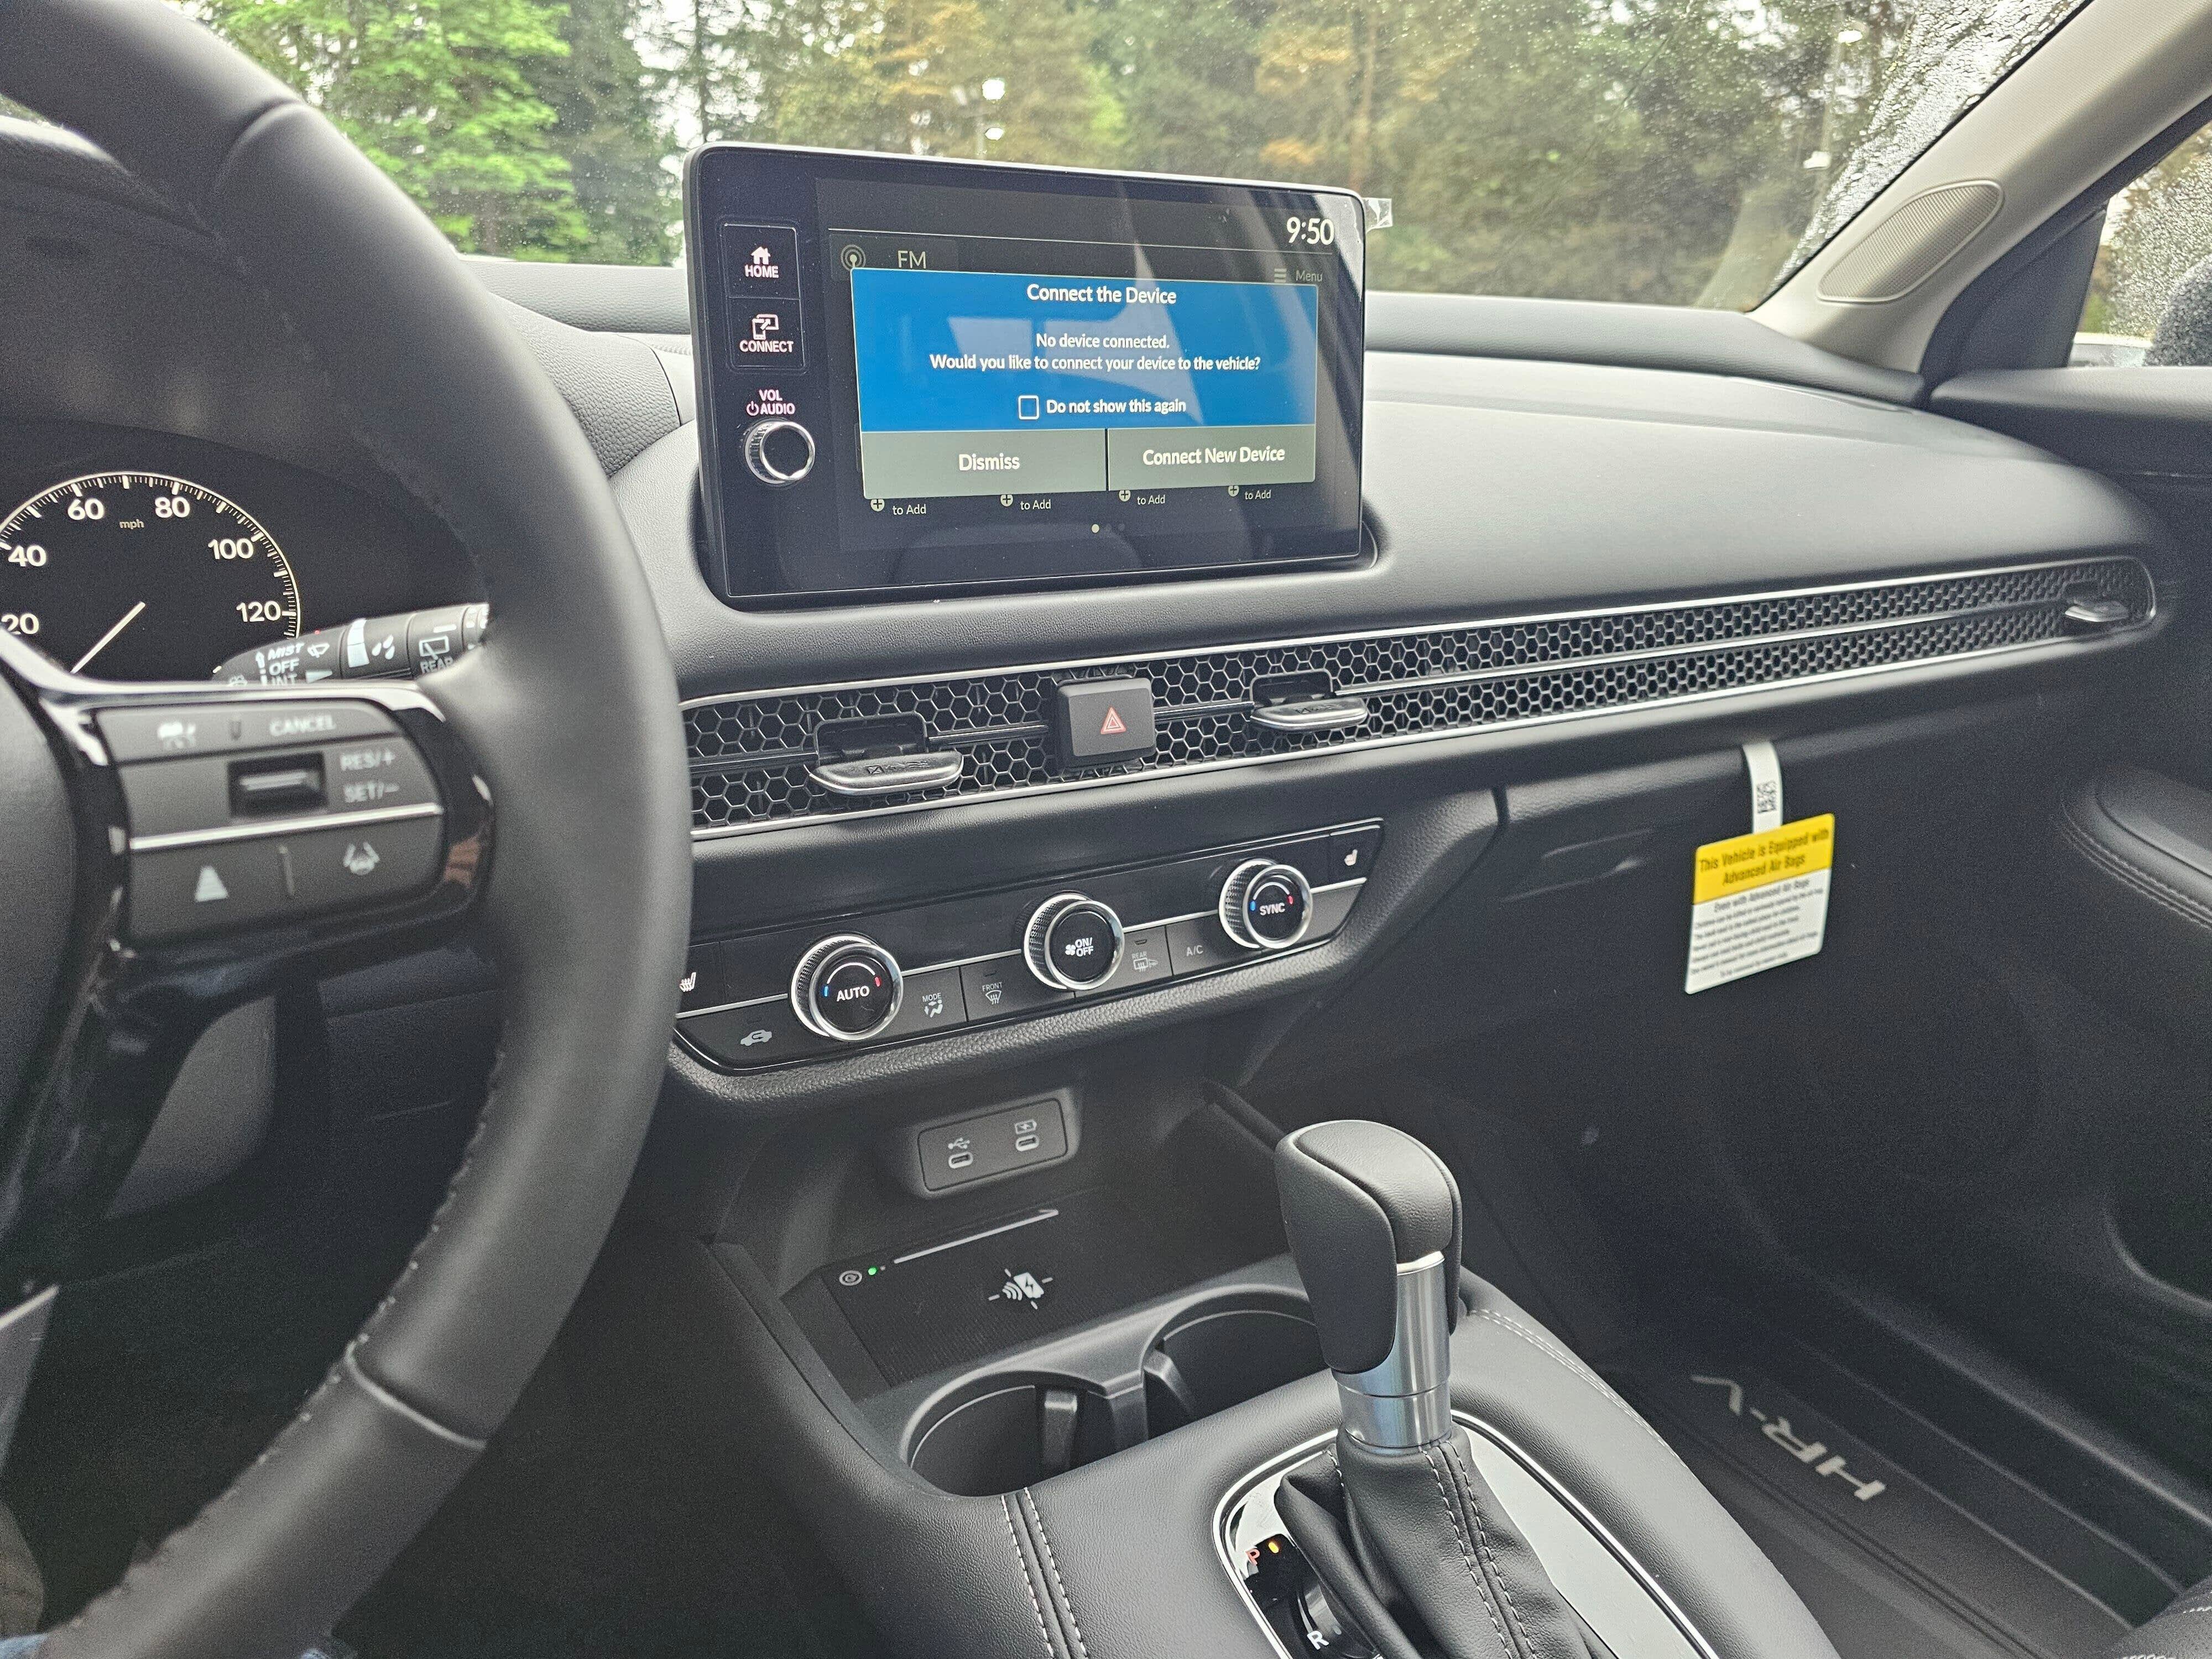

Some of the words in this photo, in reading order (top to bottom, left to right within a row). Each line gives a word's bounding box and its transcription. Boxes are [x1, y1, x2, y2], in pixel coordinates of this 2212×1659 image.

[1287, 217, 1334, 245] 9:50
[898, 251, 927, 269] FM
[745, 265, 779, 279] HOME
[1296, 270, 1322, 282] Menu
[1027, 284, 1093, 302] Connect
[1097, 286, 1121, 302] the
[1126, 287, 1177, 304] Device
[739, 340, 794, 354] CONNECT
[1036, 333, 1056, 348] No
[1059, 333, 1099, 348] device
[1103, 335, 1170, 348] connected.
[930, 354, 976, 369] Would
[979, 357, 1005, 372] you
[1008, 354, 1031, 369] like
[1034, 356, 1048, 369] to
[1051, 356, 1103, 369] connect
[1105, 359, 1134, 372] your
[1136, 356, 1175, 370] device
[1178, 357, 1191, 370] to
[1193, 356, 1213, 370] the
[1215, 356, 1261, 371] vehicle?
[759, 389, 782, 401] VOL
[760, 402, 795, 416] AUDIO
[1046, 399, 1066, 413] Do
[1069, 400, 1091, 413] not
[1093, 399, 1126, 413] show
[1129, 398, 1152, 413] this
[1154, 398, 1186, 415] again
[959, 453, 1021, 472] Dismiss
[1142, 448, 1202, 466] Connect
[1204, 447, 1237, 463] New
[1239, 445, 1285, 462] Device
[1137, 496, 1146, 505] to
[1148, 494, 1165, 505] Add
[1245, 491, 1253, 500] to
[1255, 489, 1271, 500] Add
[67, 498, 105, 520] 60
[154, 497, 190, 519] 80
[893, 505, 902, 515] to
[905, 503, 927, 515] Add
[1020, 500, 1029, 511] to
[1031, 499, 1052, 510] Add
[119, 519, 144, 530] mph
[8, 545, 47, 567] 40
[208, 539, 254, 560] 100
[236, 600, 281, 623] 120
[1, 613, 40, 635] 20
[268, 643, 305, 660] MIST
[269, 658, 299, 676] OFF
[270, 714, 336, 736] CANCEL
[1699, 858, 1719, 872] This
[1721, 849, 1755, 867] Vehicle
[1758, 844, 1766, 857] is
[1768, 832, 1808, 854] Equipped
[1812, 828, 1829, 842] with
[1723, 862, 1766, 885] Advanced
[1770, 859, 1782, 872] Air
[1785, 854, 1806, 870] Bags
[1260, 902, 1285, 916] SYNC
[1074, 937, 1093, 948] ON/
[1076, 945, 1094, 957] OFF
[1186, 945, 1203, 957] A/C
[836, 985, 870, 1002] AUTO
[982, 981, 1003, 993] FRONT
[922, 992, 941, 1002] MODE
[1691, 1375, 1886, 1501] HR-V
[1246, 1548, 1260, 1566] P
[1307, 1630, 1329, 1650] R
